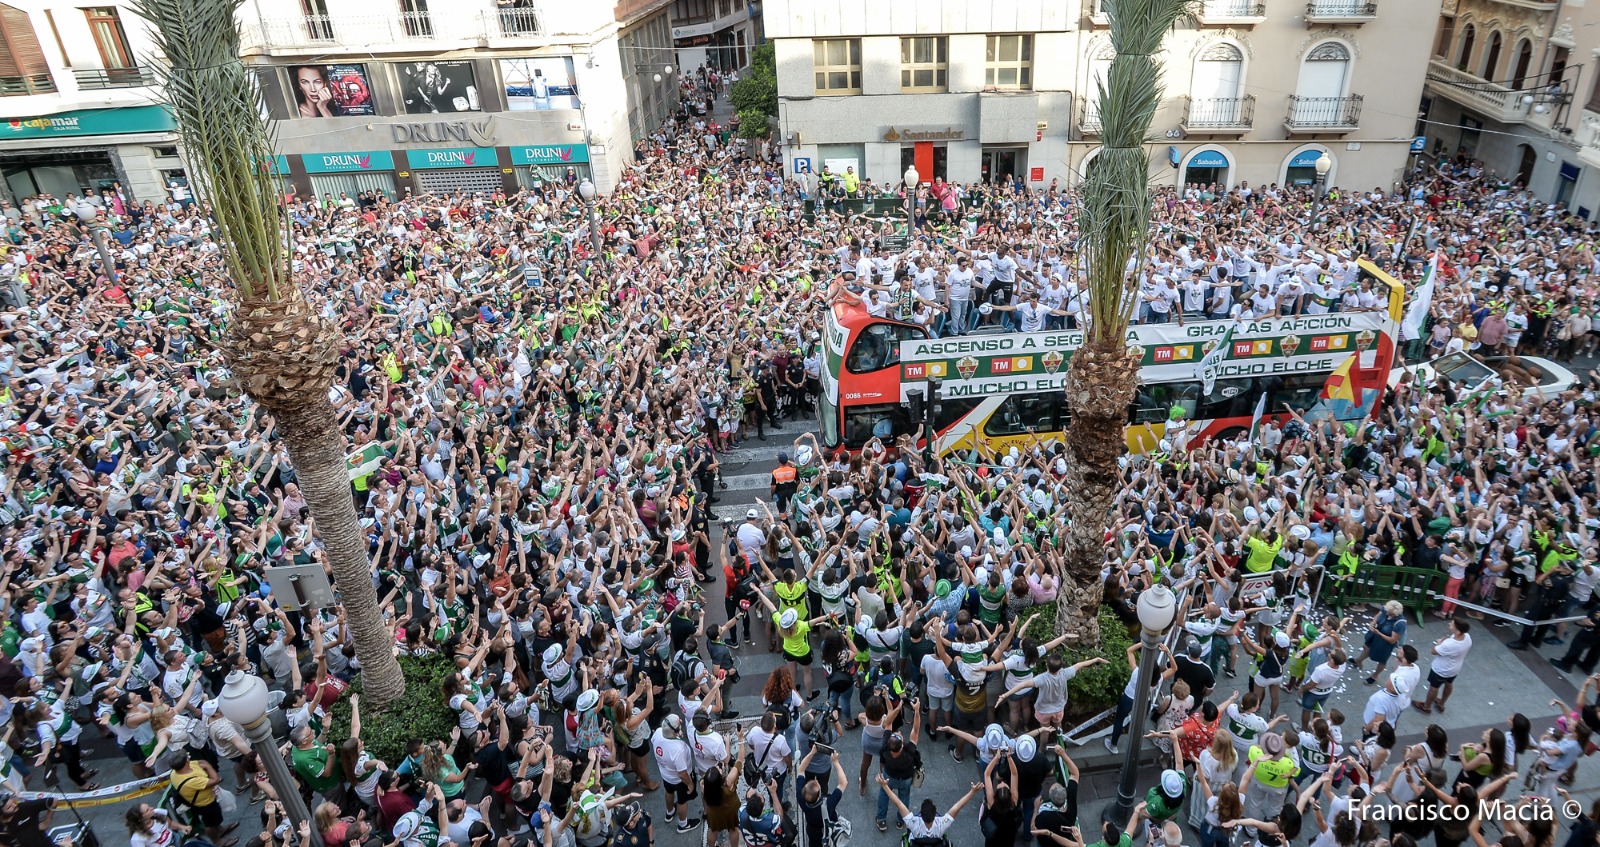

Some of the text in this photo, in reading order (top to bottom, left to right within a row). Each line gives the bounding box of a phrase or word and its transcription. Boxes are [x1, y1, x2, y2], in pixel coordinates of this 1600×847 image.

[24, 116, 78, 130] cajamar
[391, 121, 471, 143] DRUNI
[902, 127, 964, 140] Santander
[427, 151, 465, 162] DRUNI
[525, 147, 563, 159] DRUNI
[322, 155, 361, 166] DRUNI
[797, 158, 807, 173] P
[1187, 314, 1352, 337] GRAAS AFICIÓN
[915, 338, 1014, 355] ASCENSO
[1021, 337, 1036, 349] A
[1236, 344, 1250, 353] TM
[1314, 338, 1327, 348] TM
[1156, 350, 1171, 359] TM
[907, 366, 922, 376] TM
[994, 361, 1009, 370] TM
[1272, 359, 1333, 373] ELCHE
[949, 380, 1028, 397] MUCHO
[1368, 462, 1378, 475] 2
[968, 685, 981, 696] 7
[1235, 723, 1247, 736] 7
[1267, 772, 1278, 781] 7
